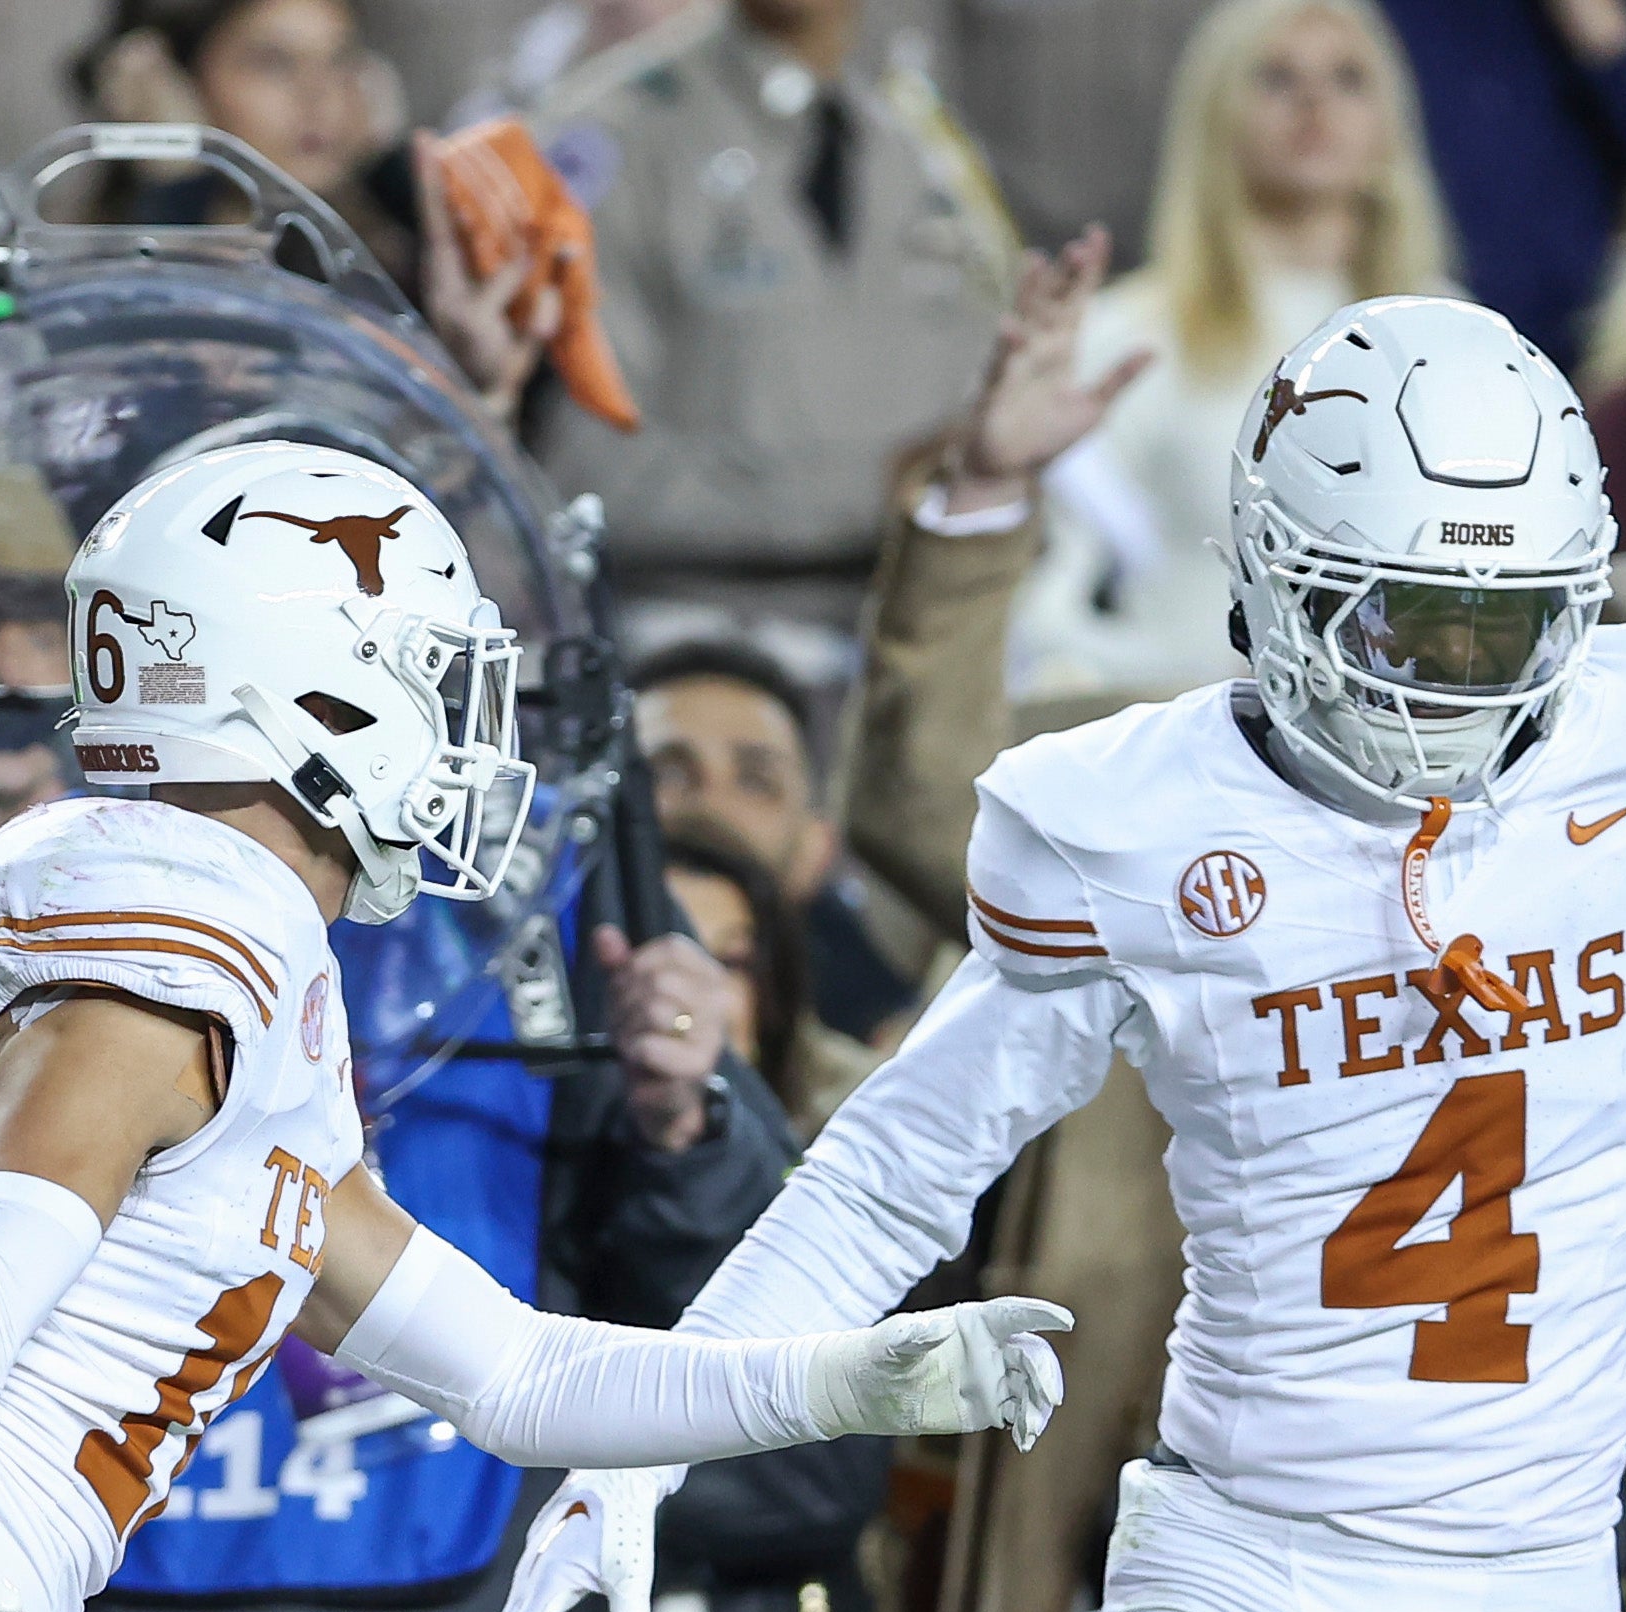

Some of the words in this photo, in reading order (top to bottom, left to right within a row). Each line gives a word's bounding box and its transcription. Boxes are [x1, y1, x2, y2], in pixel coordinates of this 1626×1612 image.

[1440, 521, 1514, 546] HORNS
[1181, 854, 1263, 933] SEC
[1251, 930, 1625, 1088] TEXAS
[1319, 1069, 1540, 1384] 4
[157, 1409, 368, 1521] 14
